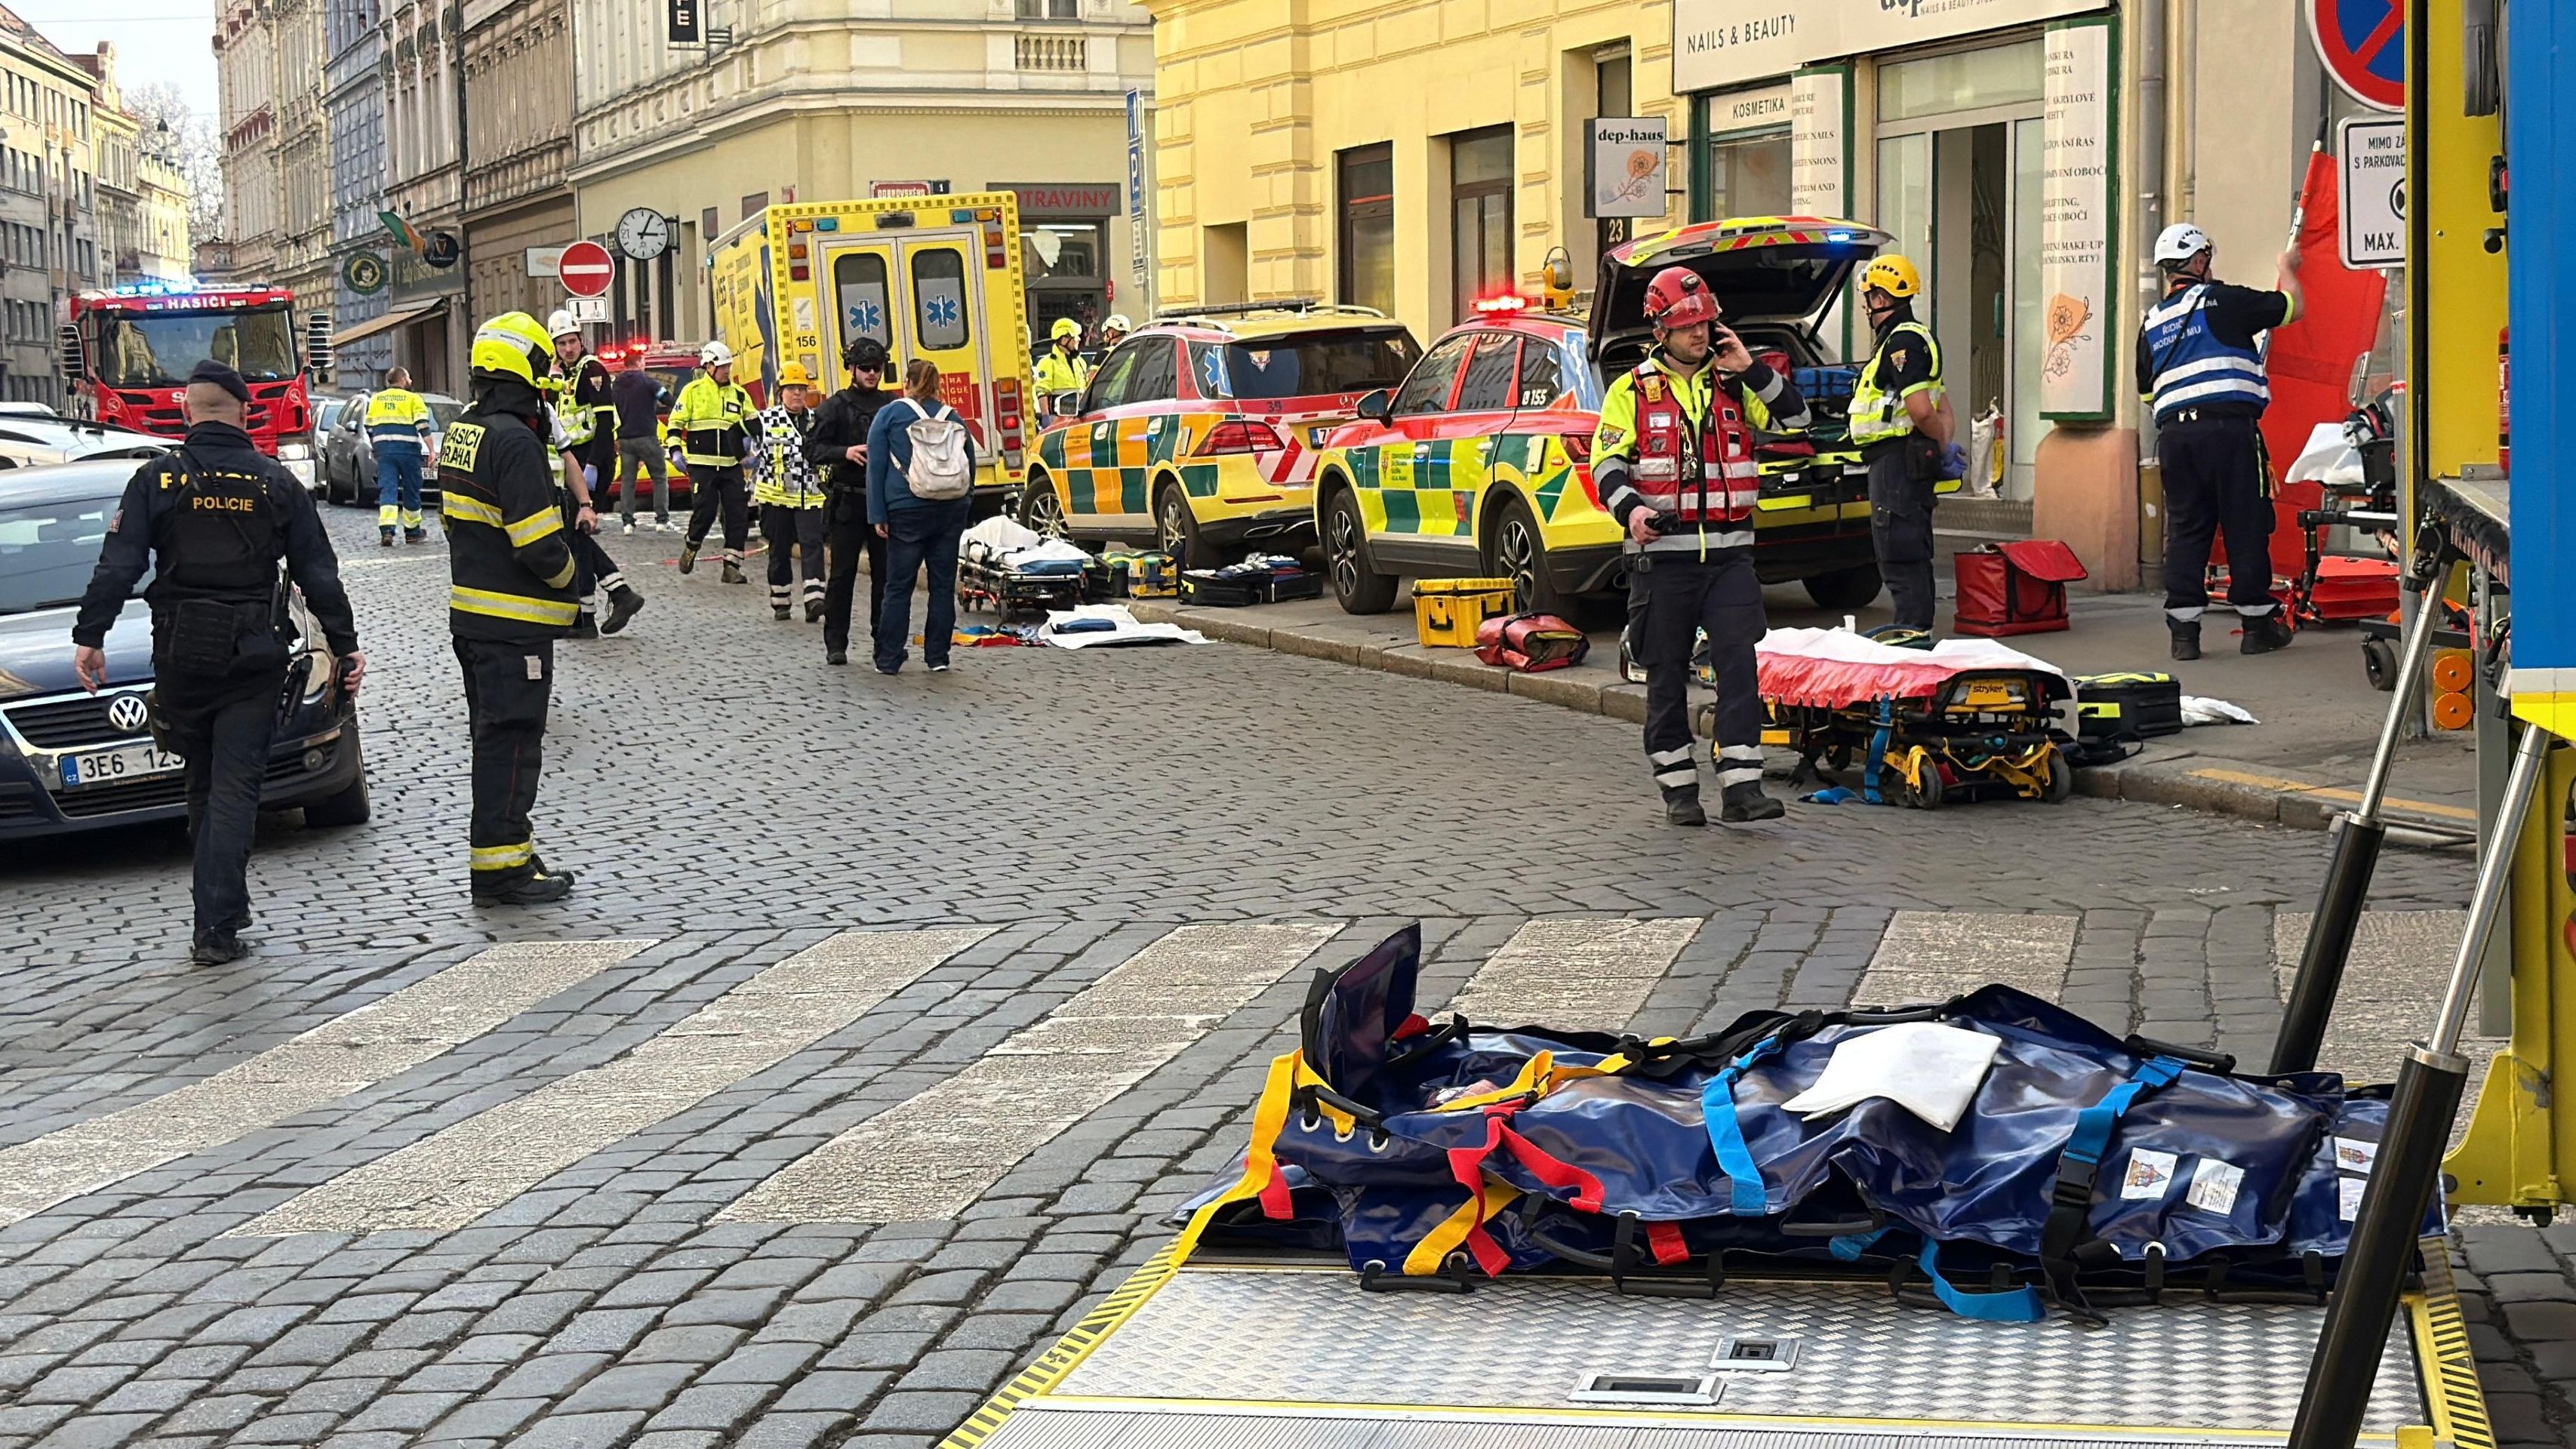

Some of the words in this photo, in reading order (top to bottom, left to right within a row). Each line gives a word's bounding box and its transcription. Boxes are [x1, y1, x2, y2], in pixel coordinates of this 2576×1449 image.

[1688, 29, 1724, 54] NAILS
[1731, 26, 1738, 45] &
[1745, 14, 1796, 42] BEAUTY
[1733, 97, 1785, 118] KOSMETIKA
[1811, 131, 1835, 140] NAILS
[2368, 136, 2391, 149] MIMO
[2354, 156, 2360, 169] S
[939, 183, 943, 192] 1
[1817, 182, 1836, 192] AND
[1017, 190, 1111, 208] TRAVINY
[1608, 219, 1623, 243] 23
[2364, 232, 2399, 251] MAX.
[168, 295, 226, 309] HASIČI
[796, 335, 816, 347] 156
[1531, 389, 1547, 405] 155
[445, 428, 481, 448] HASIČI
[193, 497, 254, 511] POLICIE
[1973, 684, 2003, 694] stryker
[83, 753, 125, 778] 3E6
